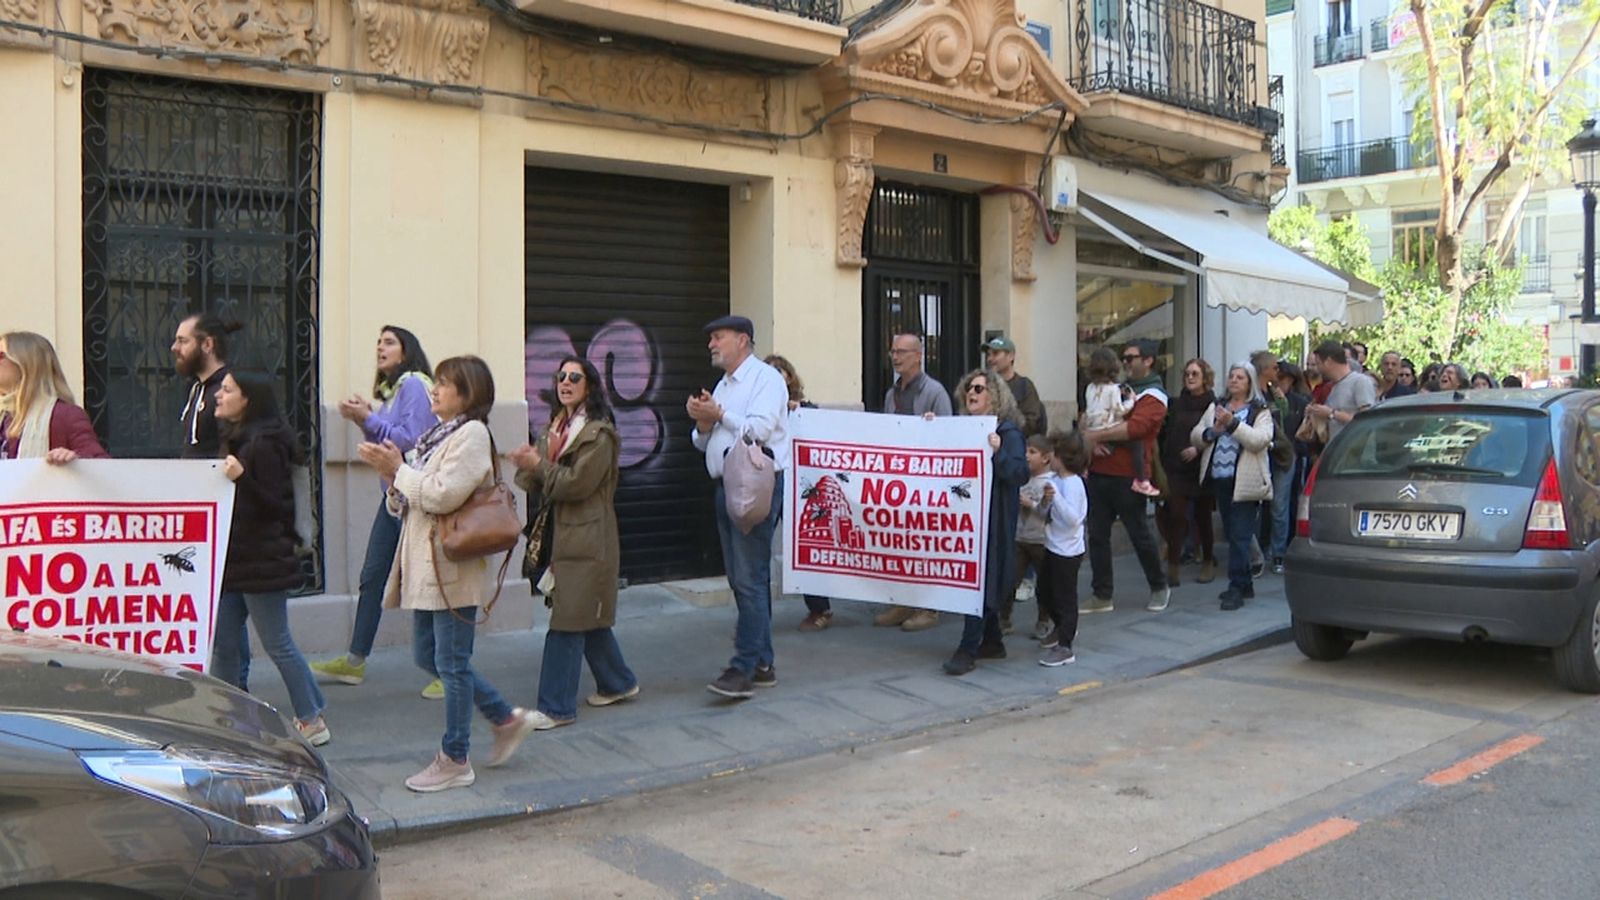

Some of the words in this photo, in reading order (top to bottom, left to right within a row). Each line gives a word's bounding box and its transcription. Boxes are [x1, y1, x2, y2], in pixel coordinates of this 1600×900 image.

[809, 448, 886, 472] RUSSAFA
[908, 456, 964, 476] BARRI!
[860, 477, 907, 507] NO
[909, 489, 922, 506] A
[927, 490, 949, 508] LA
[862, 508, 974, 532] COLMENA
[1373, 512, 1412, 531] 7570
[1416, 513, 1449, 532] GKV
[1482, 506, 1509, 515] C3
[84, 513, 185, 541] BARRI!
[868, 530, 974, 554] TURÍSTICA!
[5, 551, 88, 598] NO
[93, 562, 115, 588] A
[124, 562, 162, 587] LA
[810, 550, 885, 572] DEFENSEM
[887, 560, 901, 572] EL
[900, 558, 967, 580] VEÏNAT!
[7, 593, 199, 631] COLMENA
